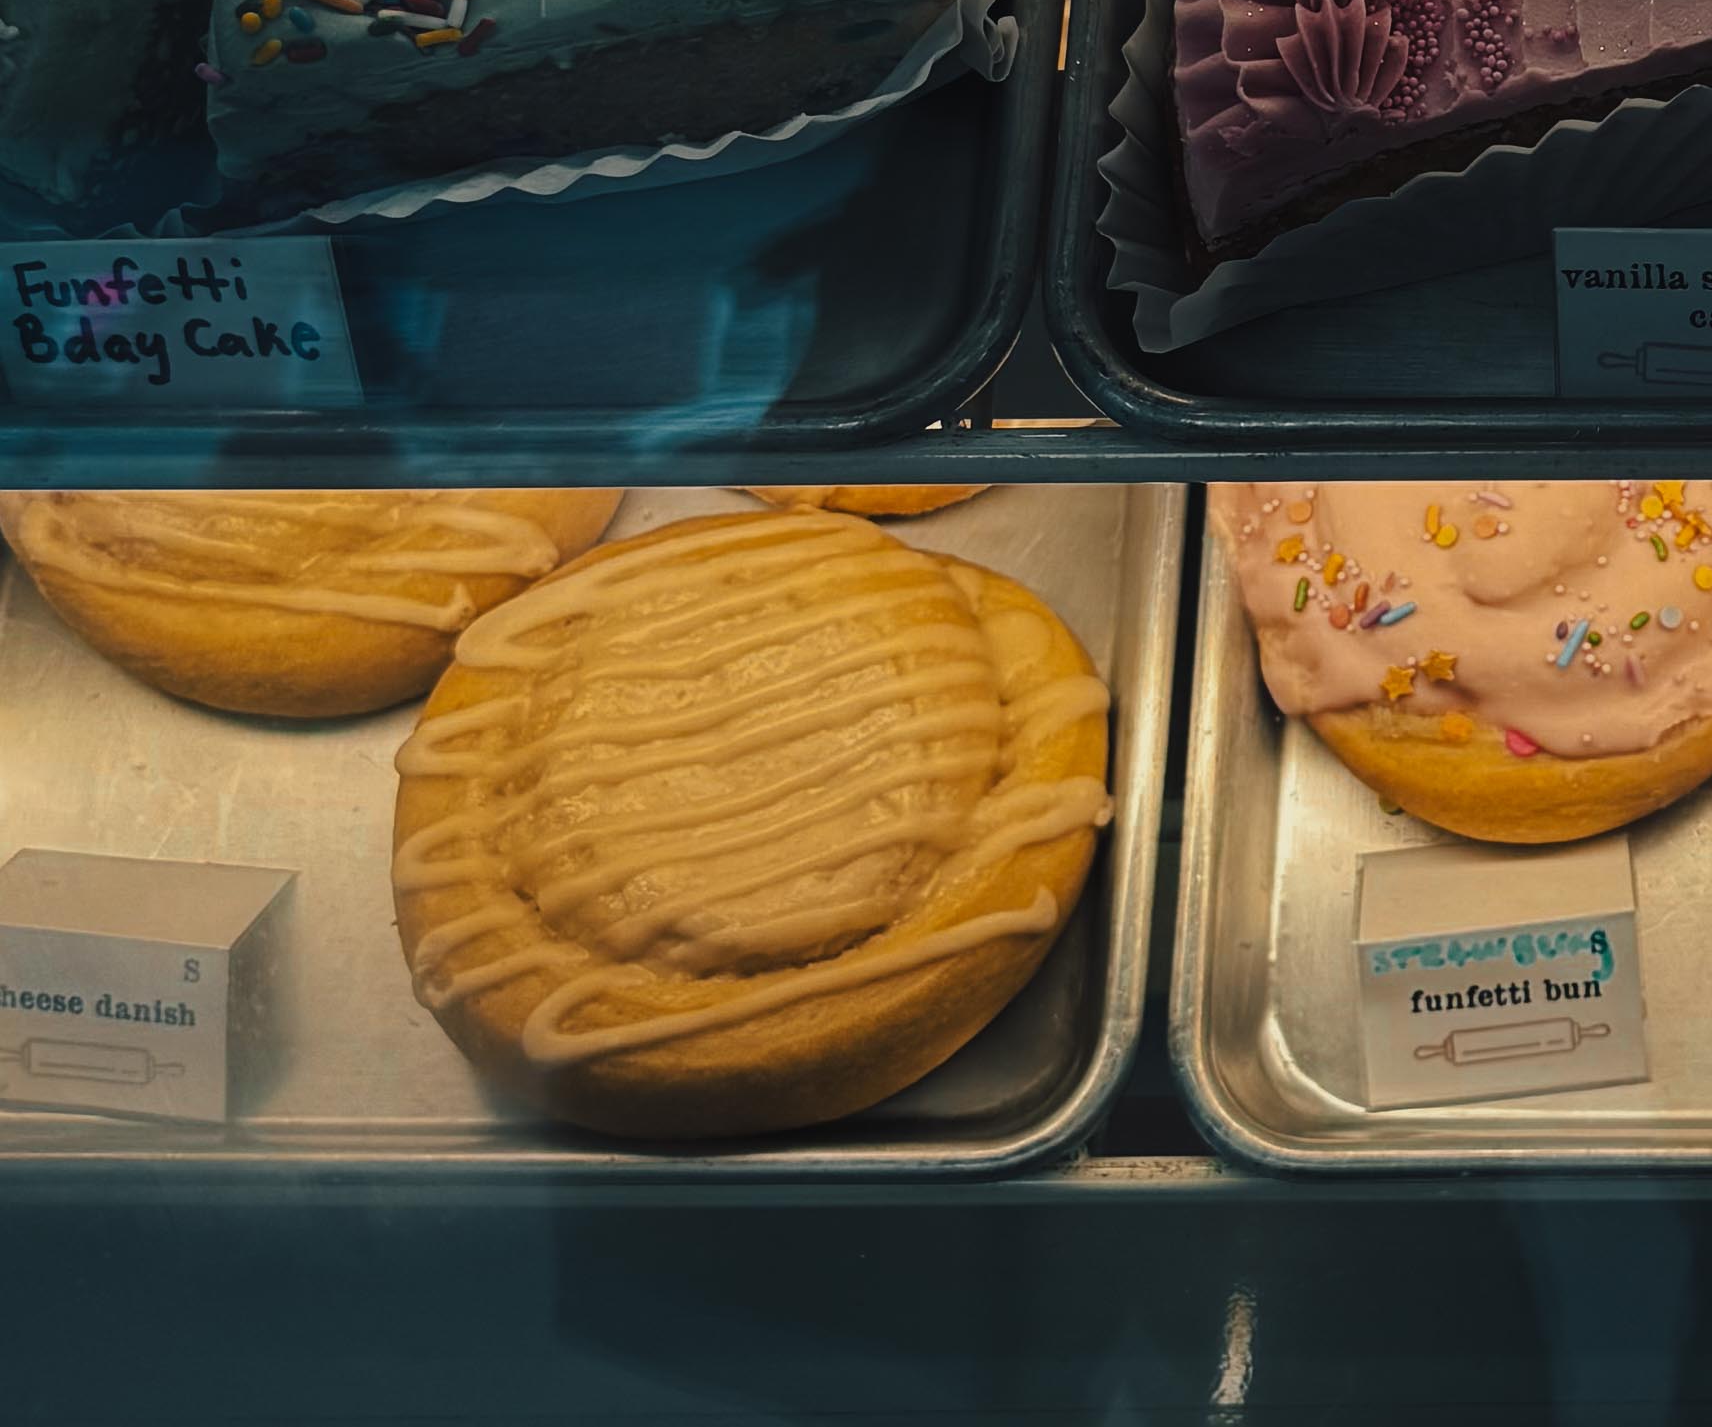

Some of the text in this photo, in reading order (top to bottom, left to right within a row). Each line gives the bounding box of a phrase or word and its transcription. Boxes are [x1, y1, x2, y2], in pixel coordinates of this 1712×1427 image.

[13, 257, 248, 308] Funfetti
[1561, 263, 1689, 290] vanilla
[13, 313, 321, 385] Bday Cake
[183, 958, 201, 983] S
[0, 985, 196, 1026] heese danish
[1412, 979, 1602, 1013] funfetti bun
